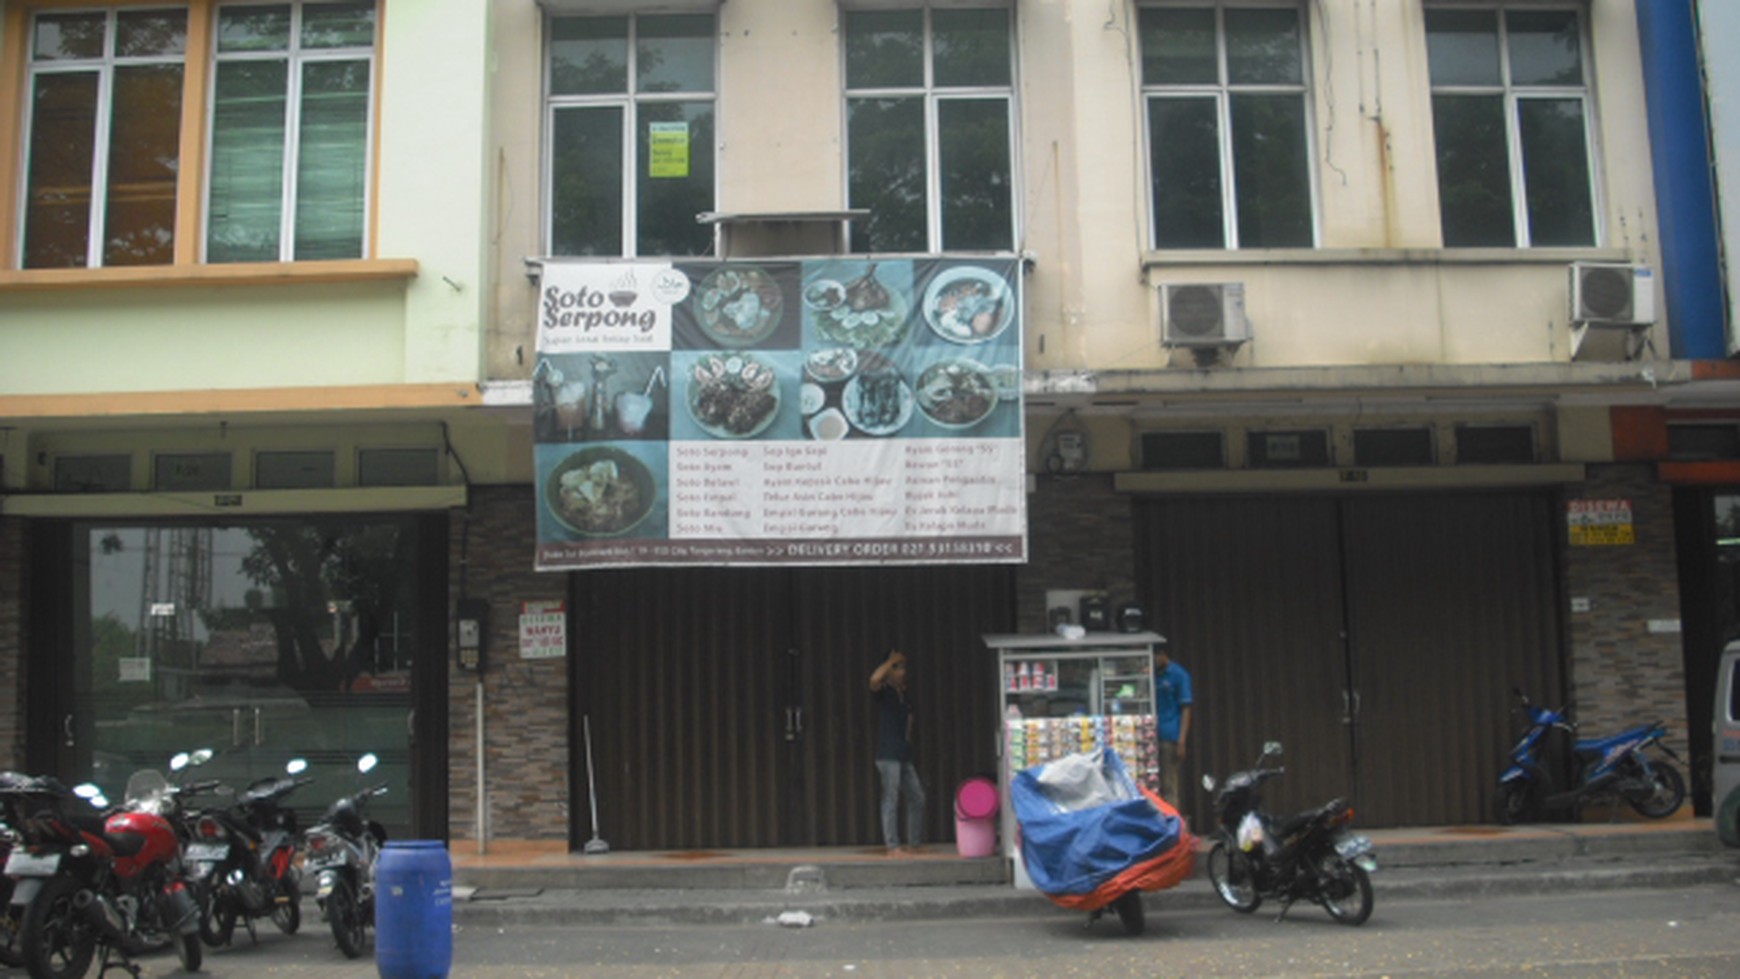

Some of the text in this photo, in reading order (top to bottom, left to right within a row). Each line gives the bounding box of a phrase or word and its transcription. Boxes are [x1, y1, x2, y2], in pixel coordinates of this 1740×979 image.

[544, 286, 604, 309] Soto
[544, 306, 656, 332] Serpong
[677, 447, 748, 458] Soto Serpong
[677, 462, 732, 472] Soto Ayam
[677, 478, 740, 487] Soto Betawi
[677, 492, 700, 501] Soto
[1567, 500, 1630, 511] DISEWA
[677, 508, 751, 519] Soto Bandung
[677, 524, 700, 533] Soto
[788, 545, 848, 556] DELIVERY
[853, 543, 898, 555] ORDER
